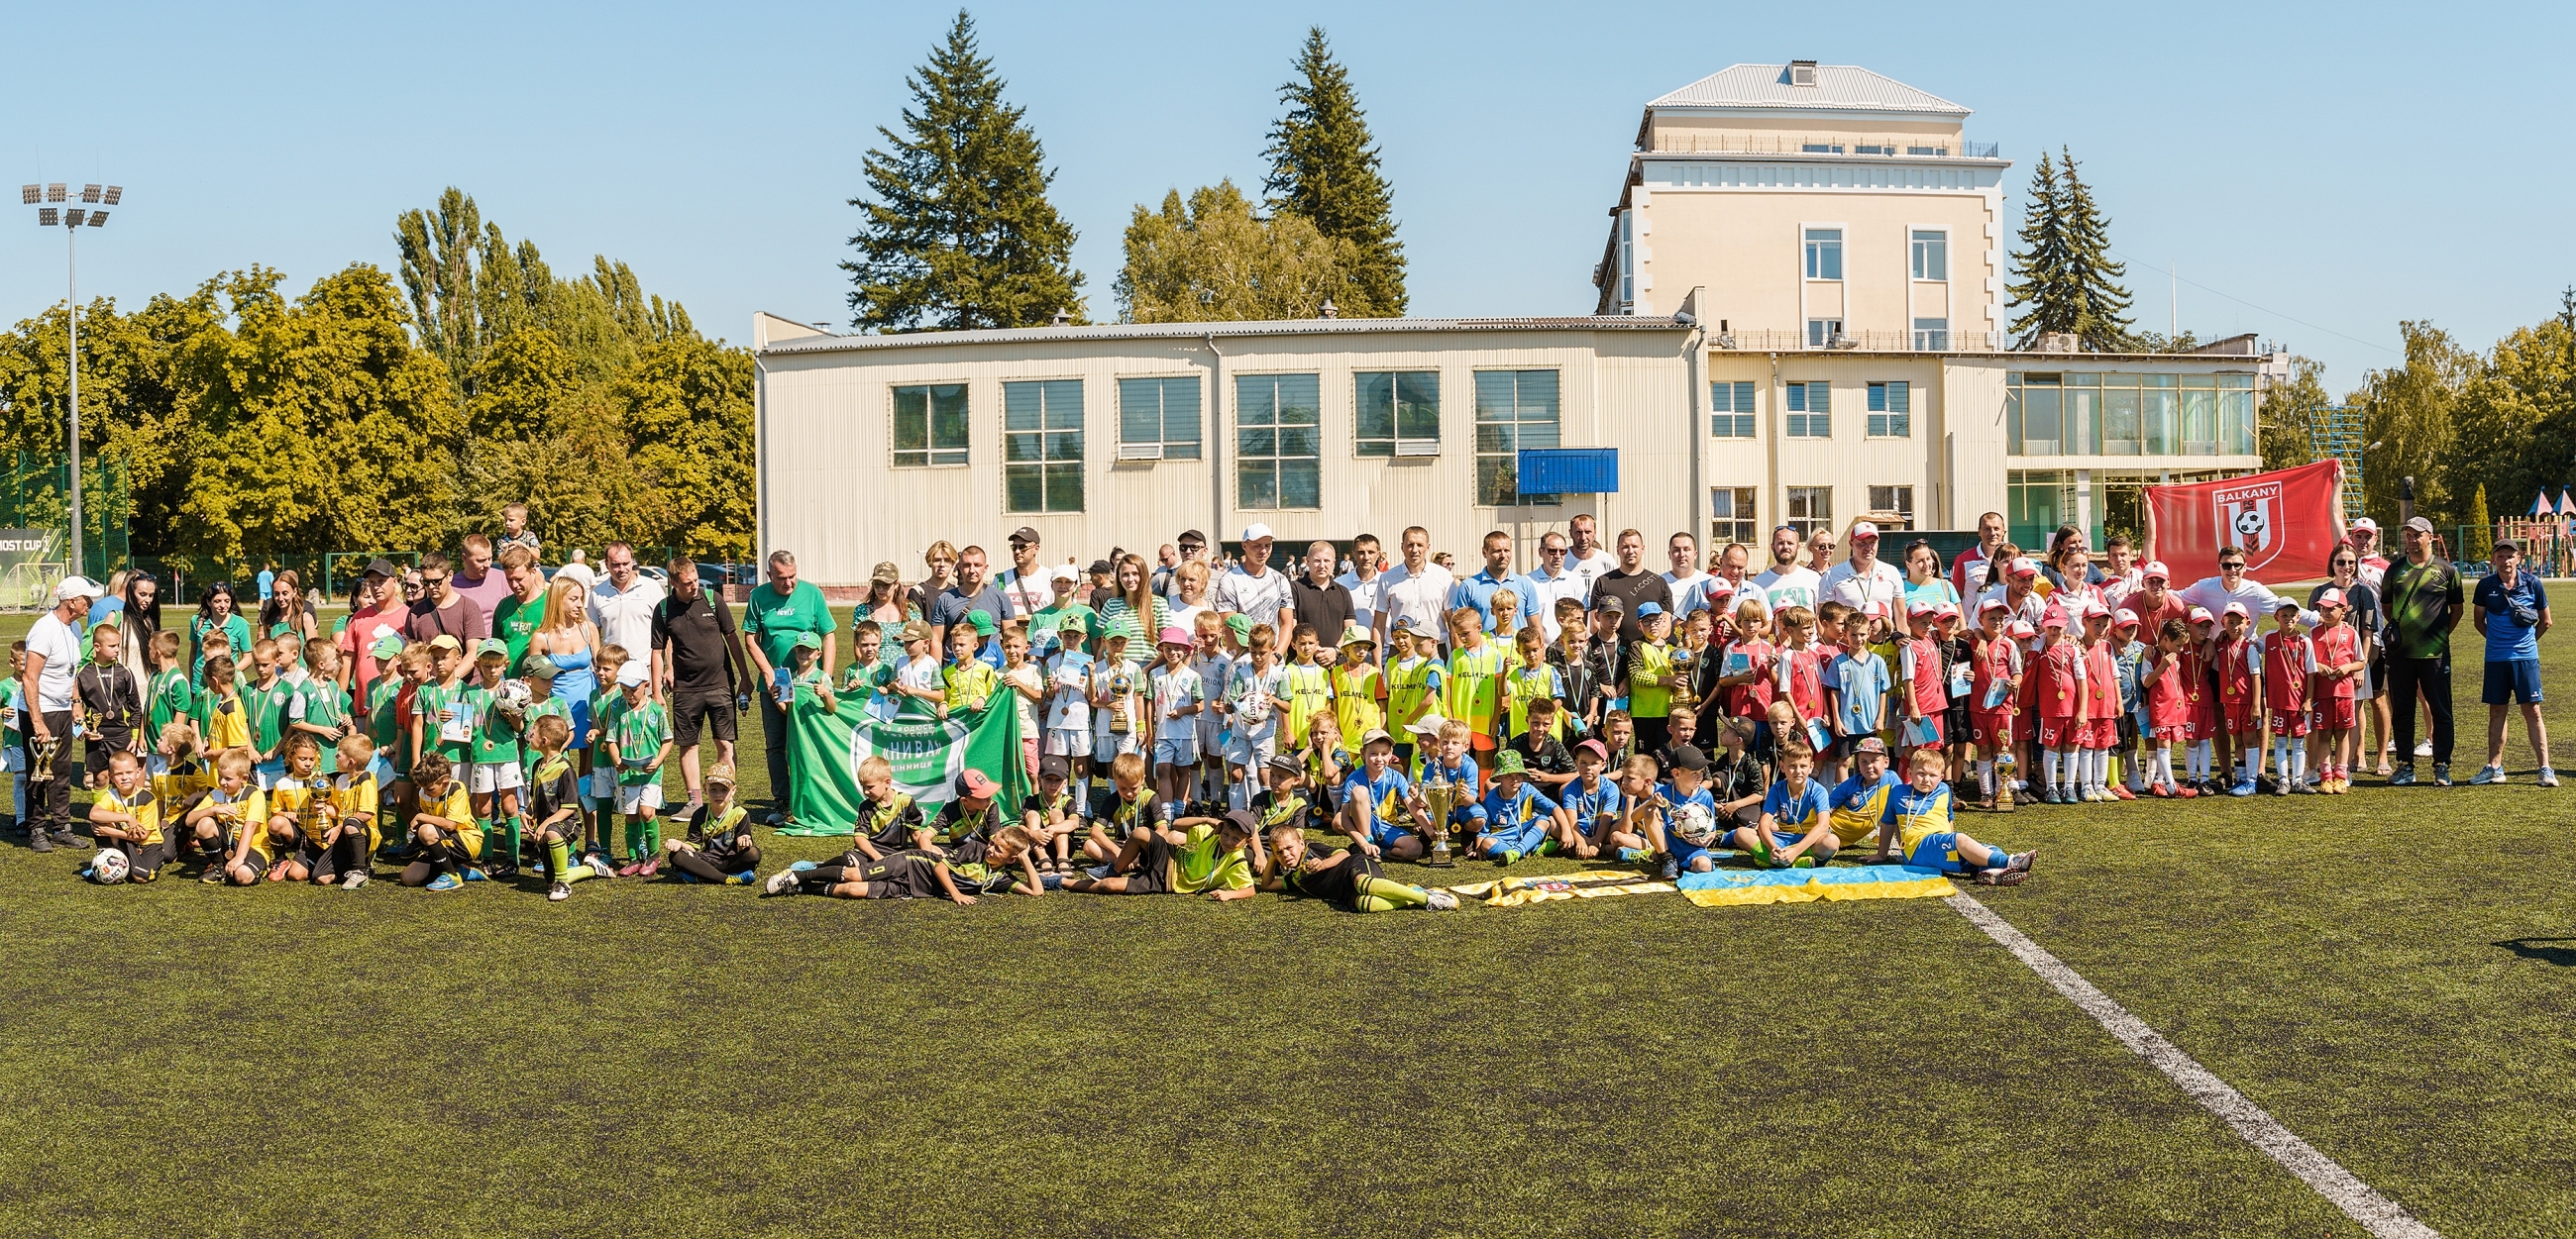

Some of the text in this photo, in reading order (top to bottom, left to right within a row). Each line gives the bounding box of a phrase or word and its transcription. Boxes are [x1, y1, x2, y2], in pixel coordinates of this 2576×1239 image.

[2217, 486, 2278, 503] BALKANY
[24, 540, 42, 552] CUP
[508, 680, 529, 694] SELECT
[2272, 716, 2284, 727] 33
[2314, 712, 2322, 723] 3
[2186, 721, 2196, 733] 81
[2044, 728, 2055, 740] 25
[2084, 729, 2093, 741] 25
[891, 761, 933, 773] ВІННИЦЯ
